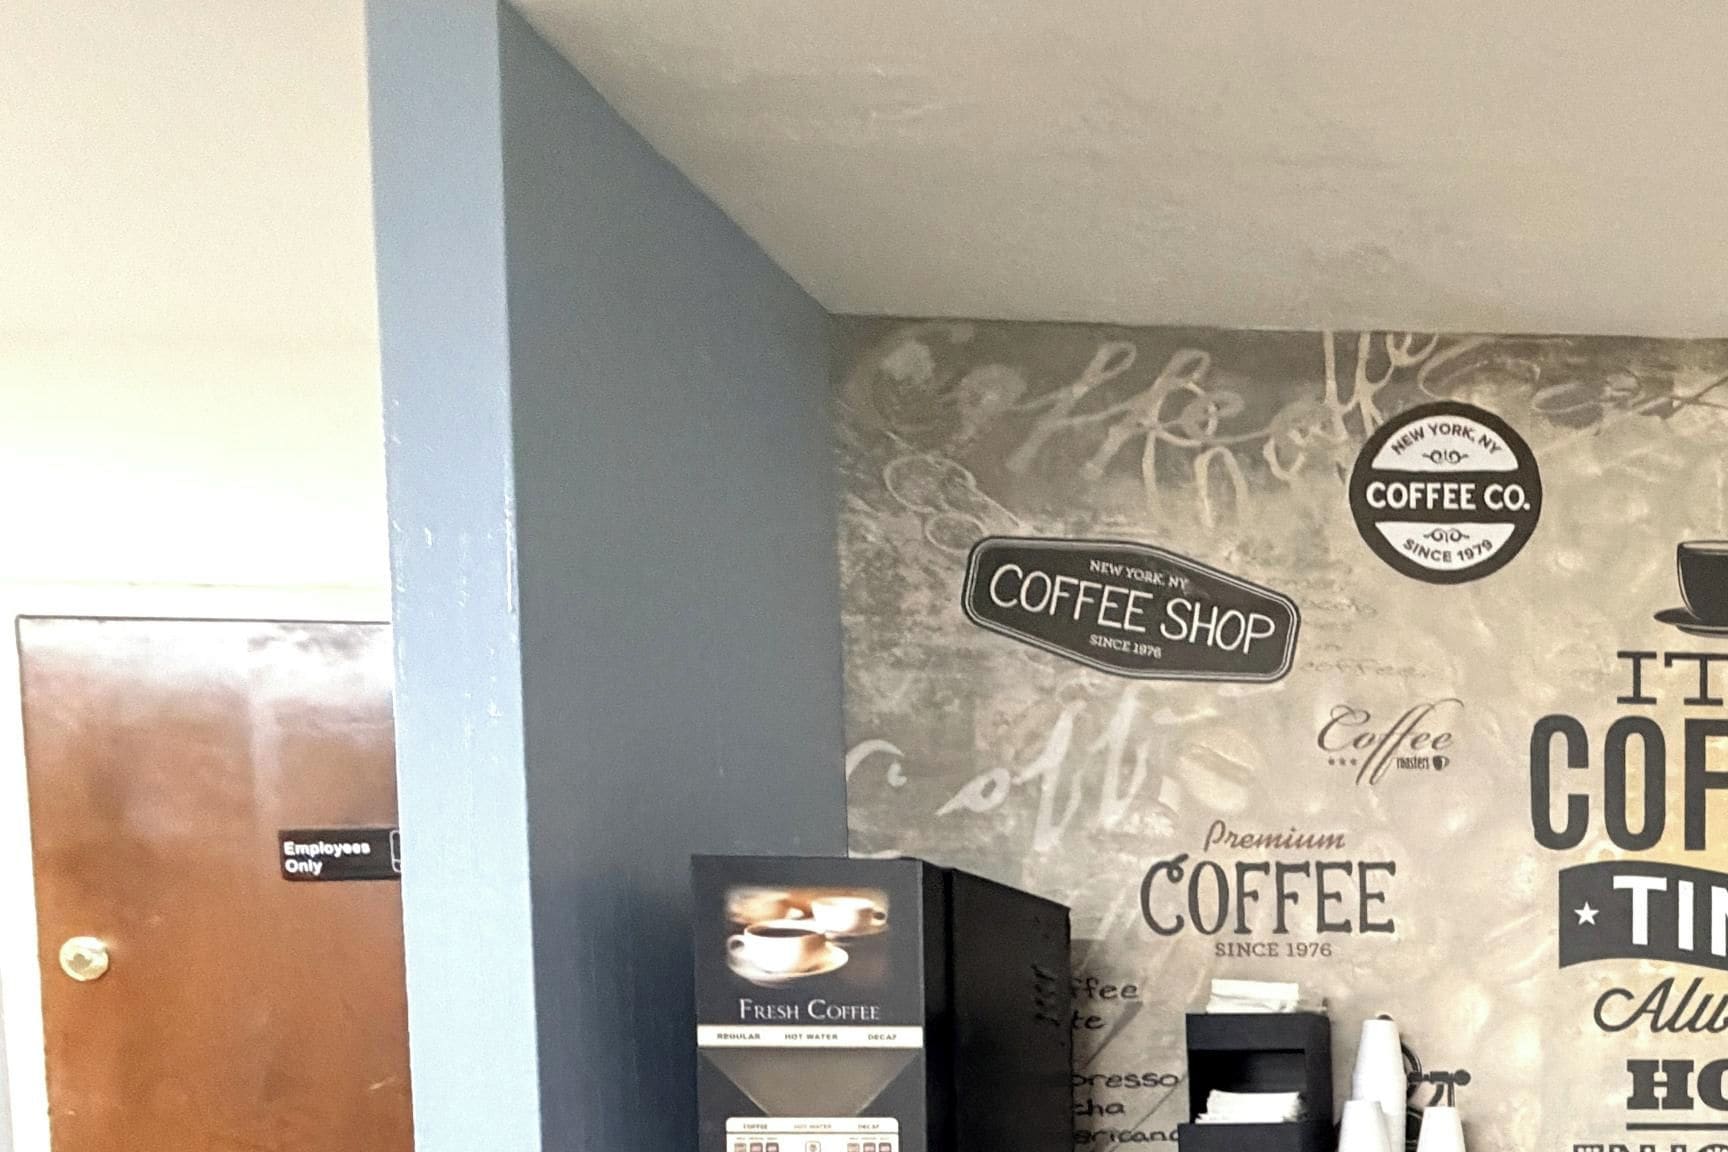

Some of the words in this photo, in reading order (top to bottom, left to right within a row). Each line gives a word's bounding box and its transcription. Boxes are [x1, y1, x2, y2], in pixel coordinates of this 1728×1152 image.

[1391, 426, 1425, 455] NEW
[1478, 434, 1502, 454] NY
[1366, 481, 1476, 510] COFFEE
[1483, 483, 1531, 511] CO.
[1403, 538, 1452, 562] SINCE
[1457, 539, 1493, 561] 1979
[1090, 560, 1122, 576] NEW
[1169, 575, 1189, 589] NY
[989, 563, 1153, 632] COFFEE
[1160, 598, 1275, 654] SHOP
[1090, 634, 1130, 653] SINCE
[1317, 698, 1465, 786] Coffee
[1202, 819, 1346, 853] Premium
[283, 841, 371, 858] Employees
[285, 859, 323, 876] Only
[1140, 853, 1397, 937] COFFEE
[1214, 942, 1279, 958] SINCE
[1286, 942, 1333, 958] 1976
[739, 998, 799, 1020] FRESH
[807, 998, 881, 1020] COFFEE
[717, 1033, 761, 1041] REGULAR
[784, 1033, 803, 1041] HOT
[806, 1033, 839, 1041] WATER
